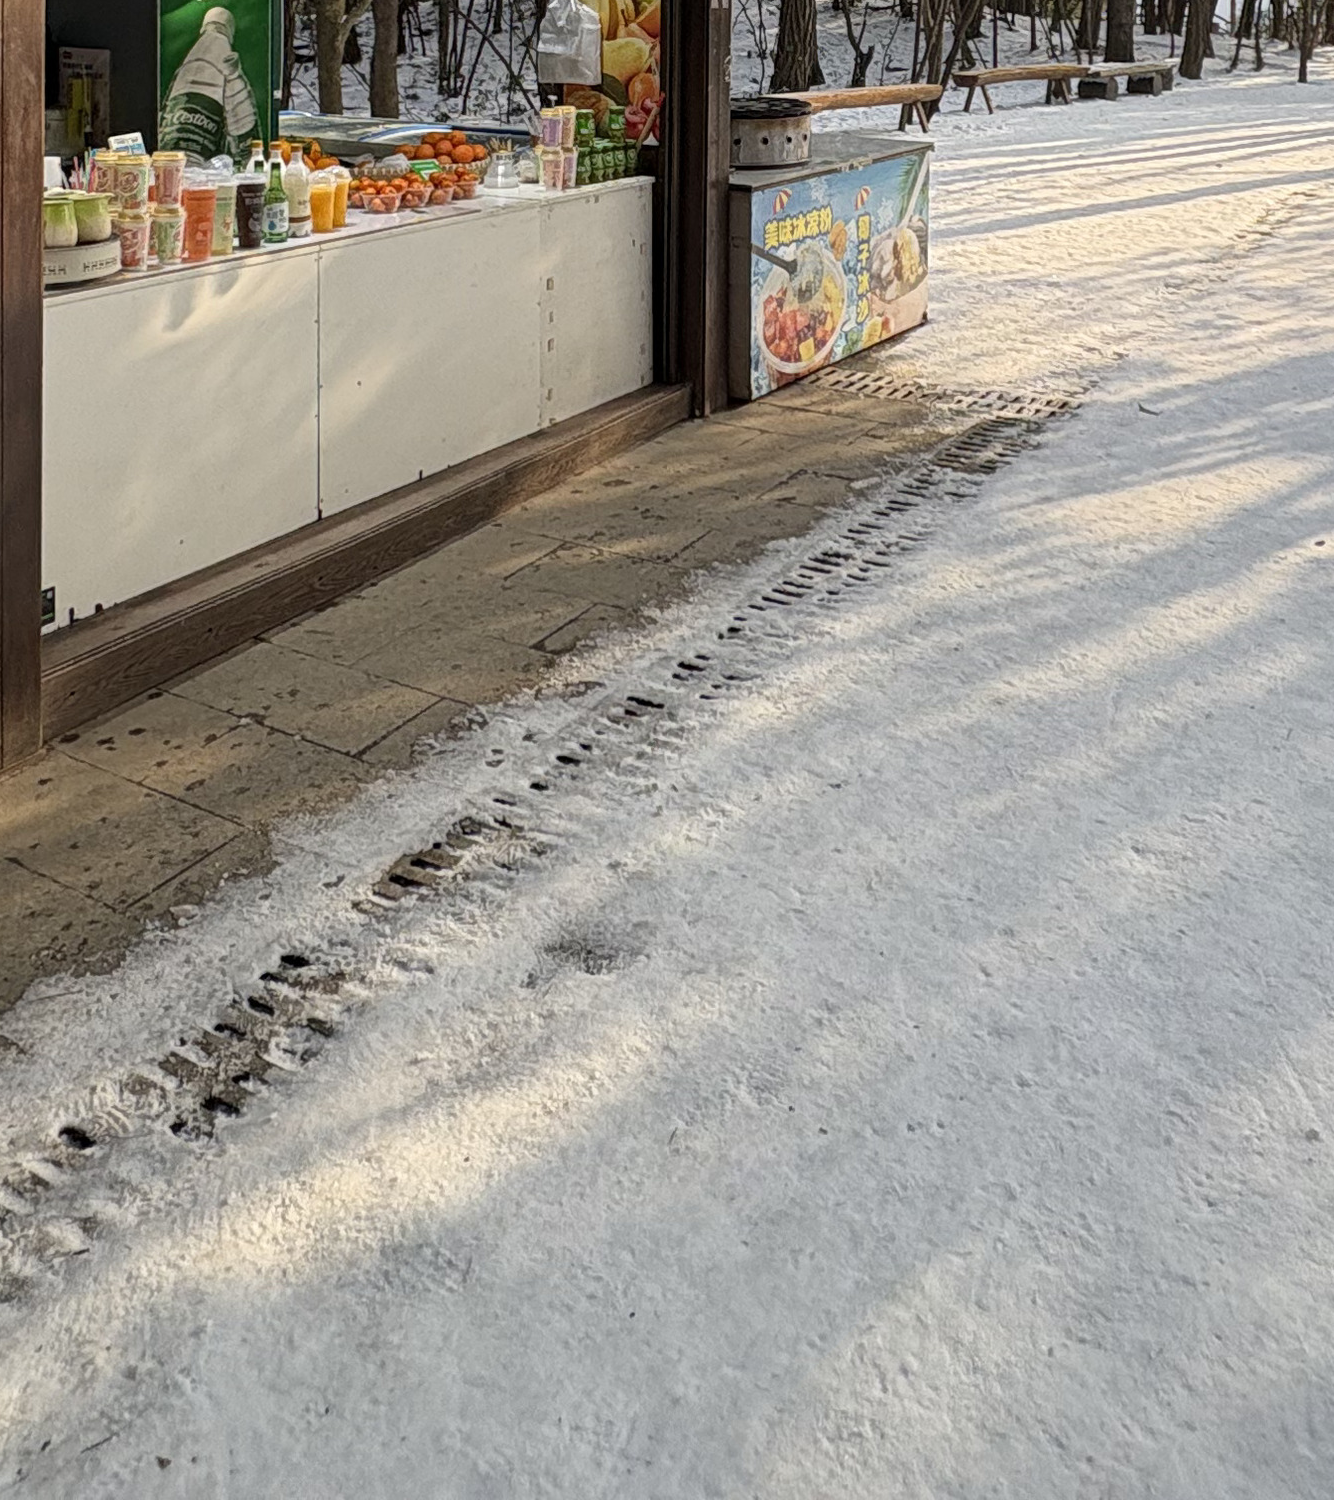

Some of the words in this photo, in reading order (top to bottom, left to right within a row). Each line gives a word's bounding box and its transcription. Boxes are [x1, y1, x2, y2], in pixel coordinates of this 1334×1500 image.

[764, 204, 833, 251] 美味冰凉粉
